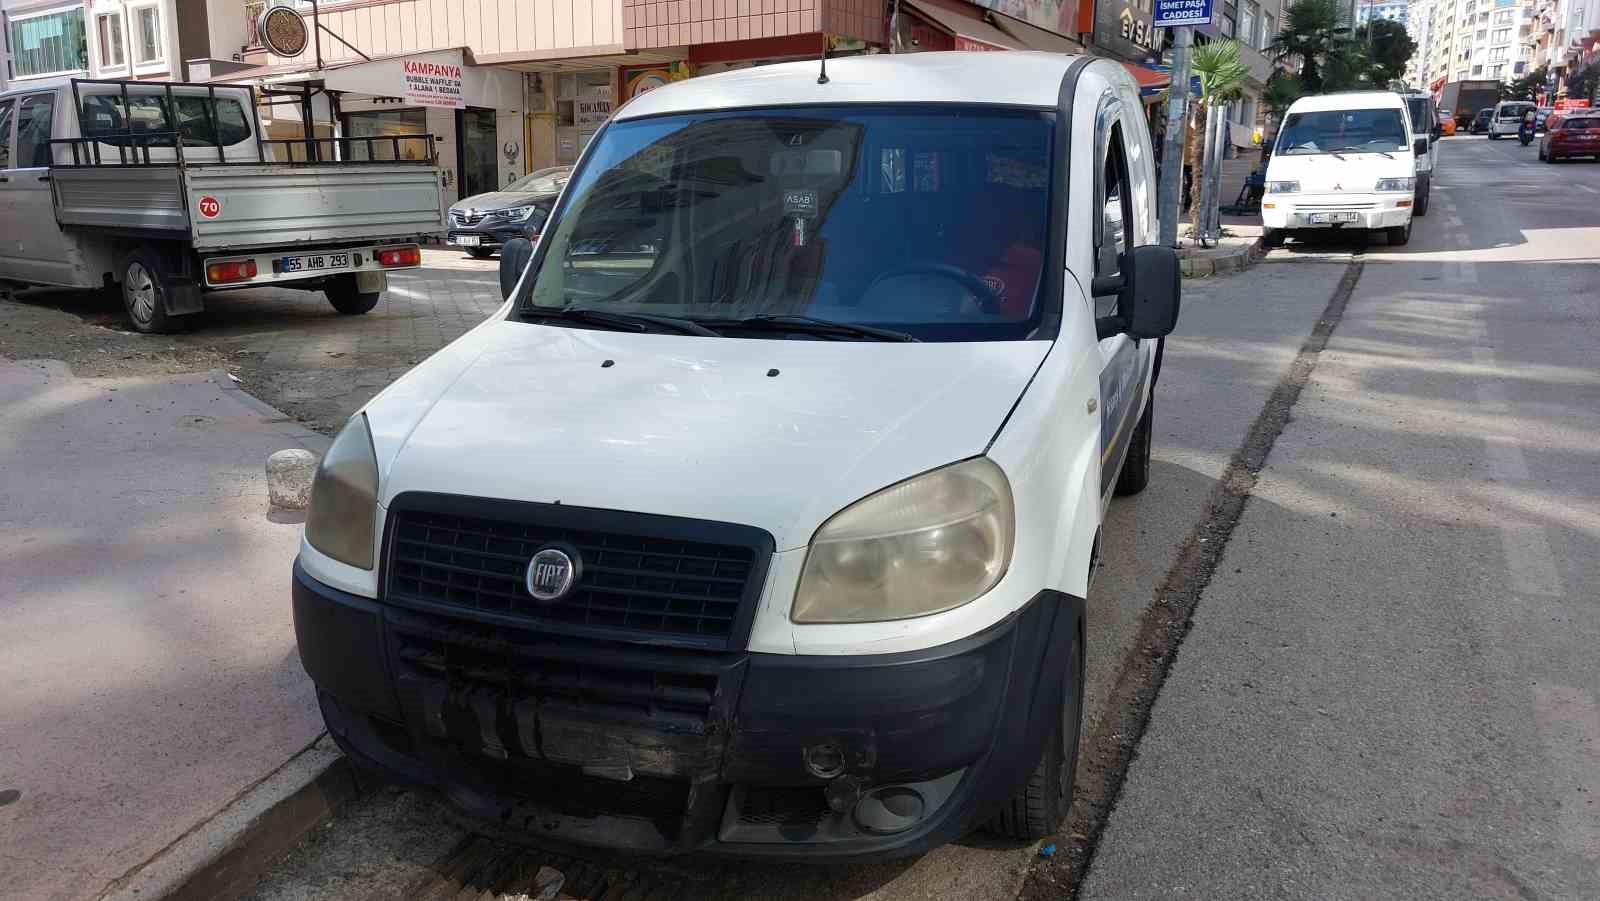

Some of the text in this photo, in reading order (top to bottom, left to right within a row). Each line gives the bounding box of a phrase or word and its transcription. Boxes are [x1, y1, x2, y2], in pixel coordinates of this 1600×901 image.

[1160, 0, 1184, 9] İSMET
[1163, 8, 1203, 19] CADDESİ
[404, 61, 461, 78] KAMPANYA
[201, 202, 218, 213] 70
[289, 253, 347, 271] 55 AHB 293
[535, 563, 564, 586] FIAT
